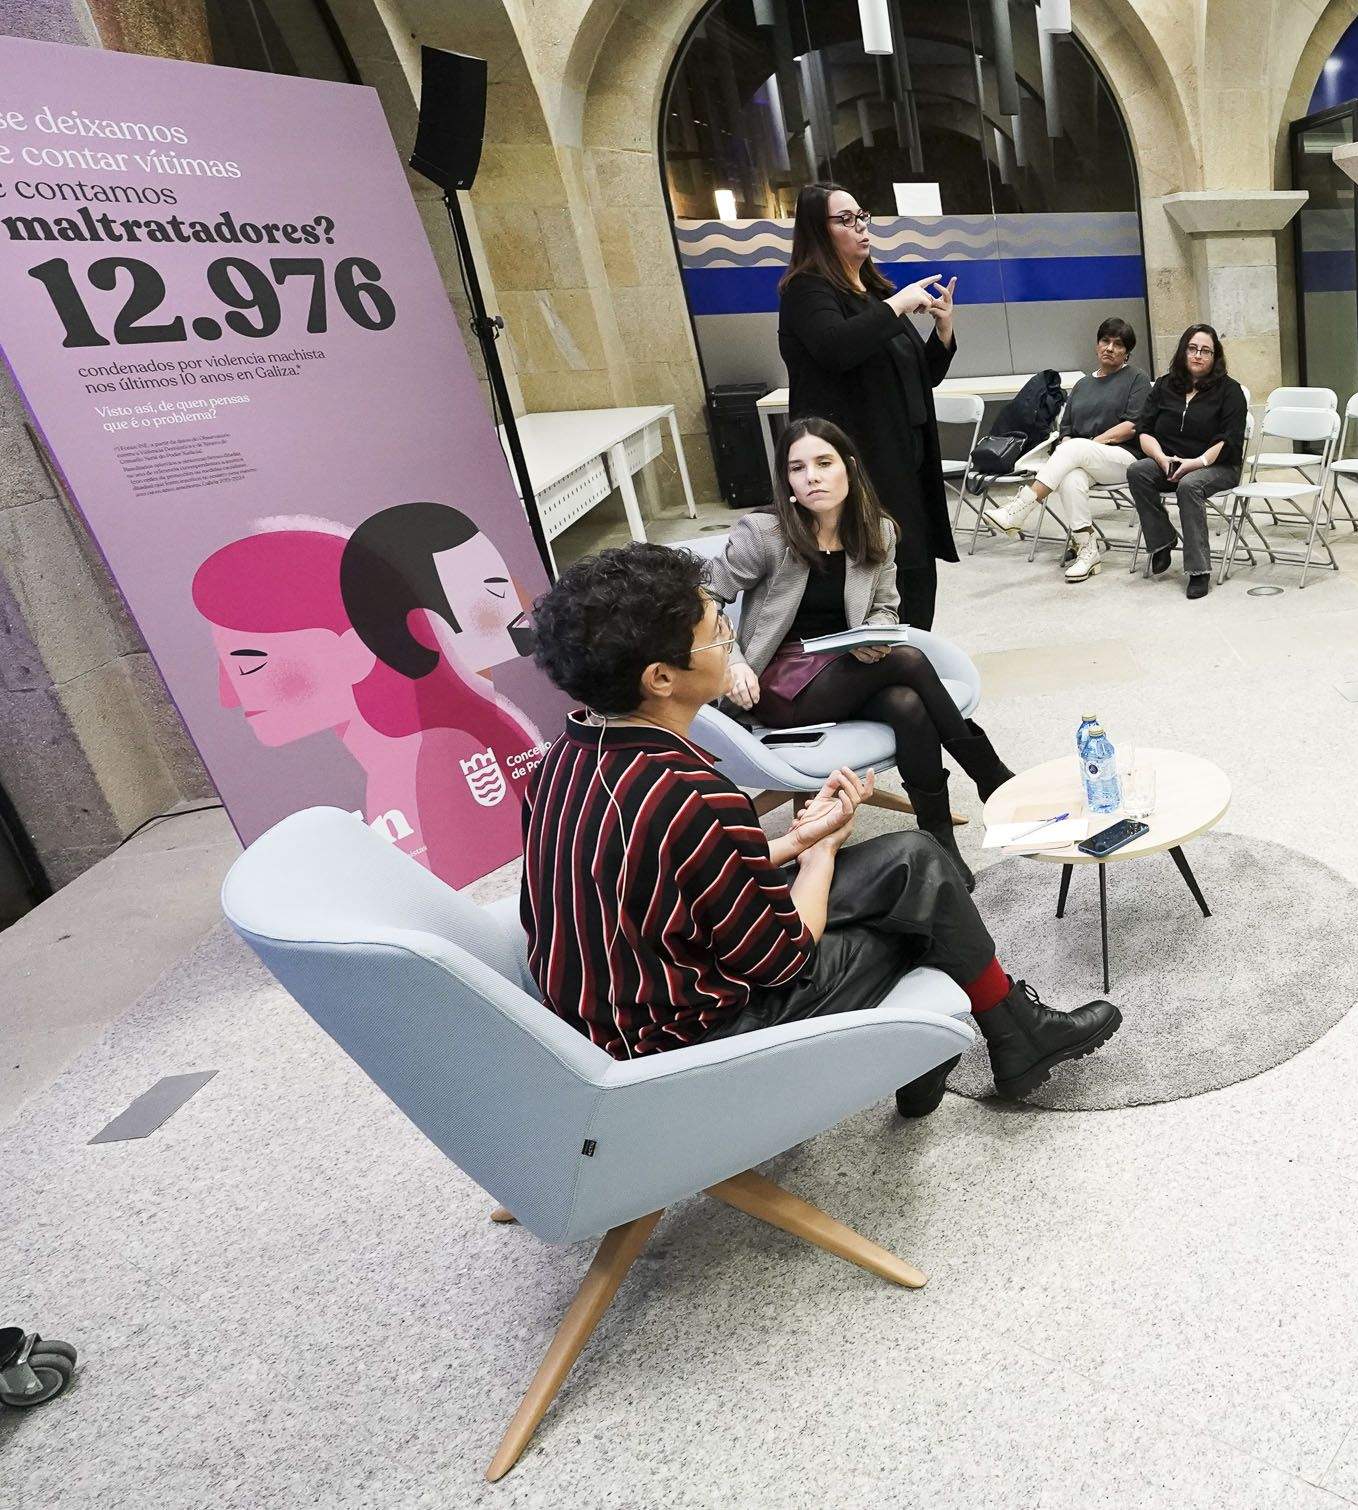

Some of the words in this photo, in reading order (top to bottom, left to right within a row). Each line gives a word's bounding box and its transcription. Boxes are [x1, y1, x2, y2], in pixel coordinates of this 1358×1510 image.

[35, 106, 188, 145] deixamos
[22, 147, 129, 172] contar
[135, 149, 242, 179] vítimas
[15, 180, 178, 205] contamos
[1, 206, 335, 244] maltratadores?
[28, 257, 396, 348] 12.976
[78, 359, 175, 377] condenados
[178, 359, 202, 372] por
[205, 353, 266, 367] violencia
[268, 349, 326, 362] machista
[85, 382, 117, 394] nos
[119, 377, 178, 391] últimos
[200, 372, 234, 384] anos
[237, 370, 254, 380] en
[94, 406, 132, 417] Visto
[134, 402, 157, 414] así,
[158, 400, 175, 411] de
[176, 399, 208, 412] quen
[209, 394, 250, 408] pensas
[103, 420, 129, 433] que
[129, 417, 140, 428] é
[141, 418, 151, 427] o
[153, 408, 217, 428] problema?
[511, 767, 527, 779] de
